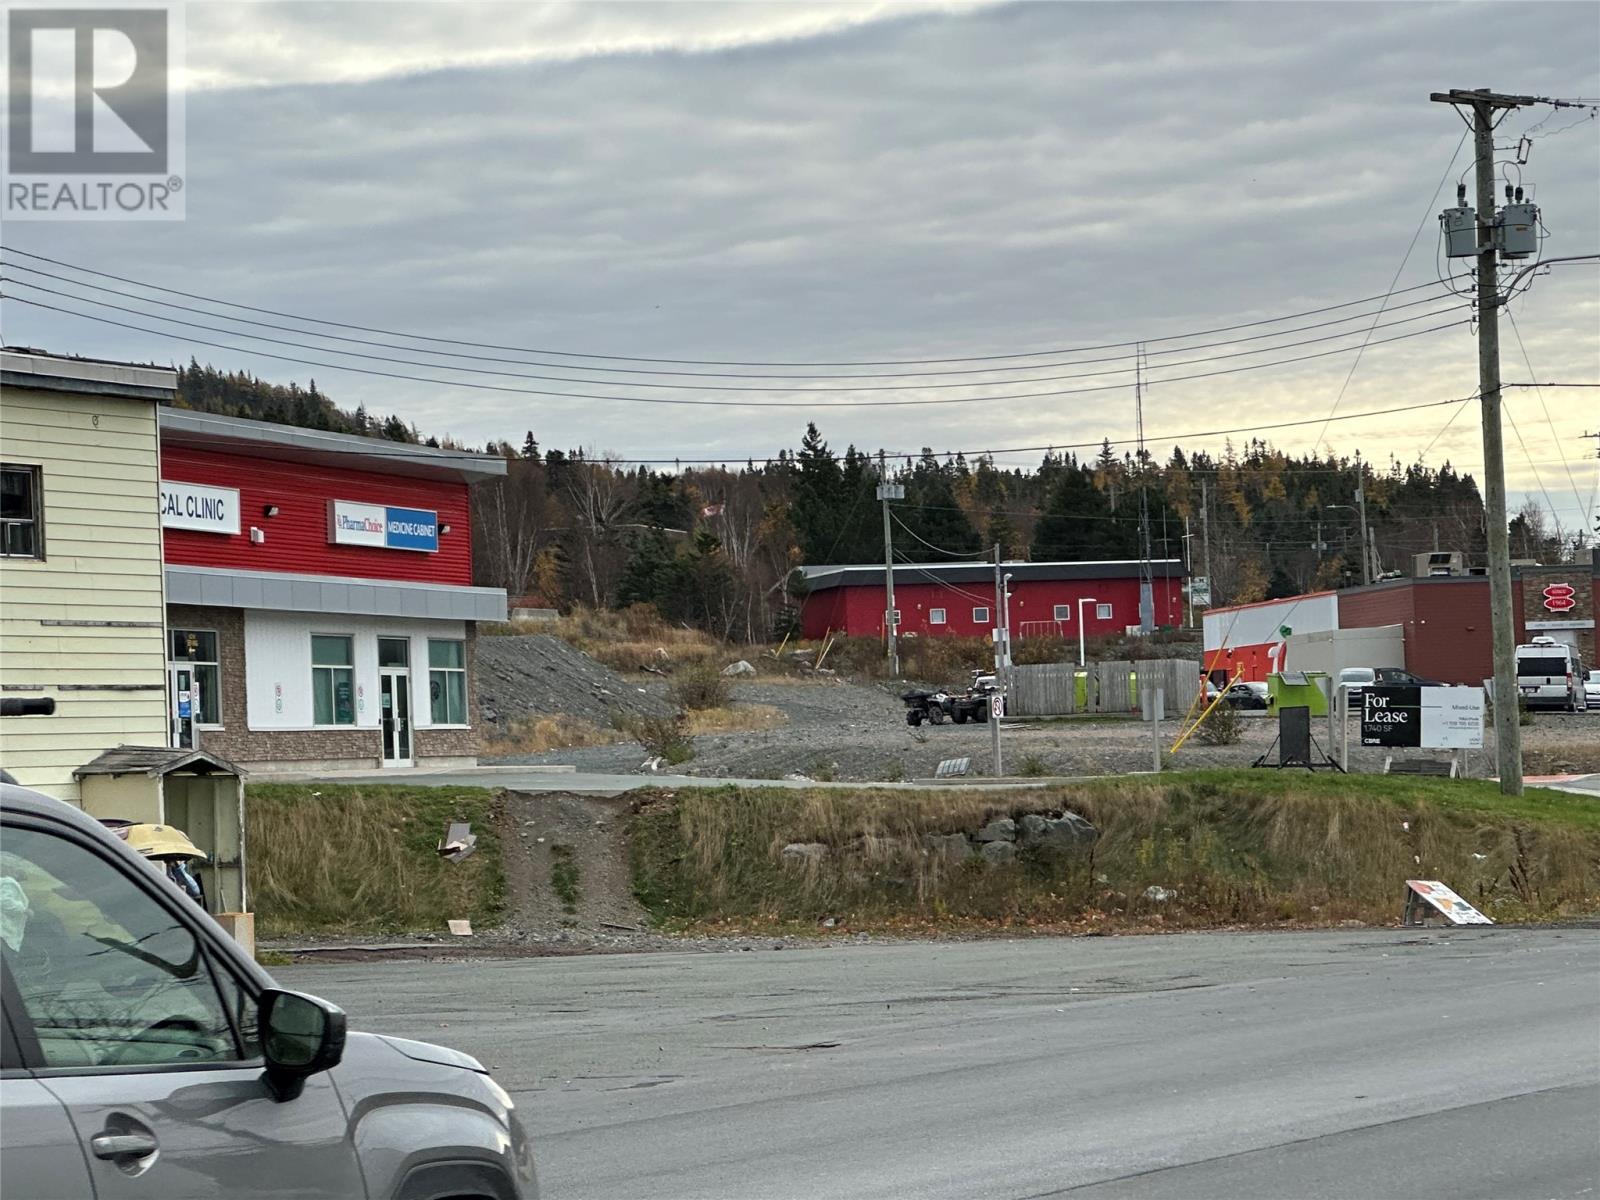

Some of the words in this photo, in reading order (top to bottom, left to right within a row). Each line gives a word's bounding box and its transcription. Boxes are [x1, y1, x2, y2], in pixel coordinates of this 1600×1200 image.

[186, 495, 224, 521] CLINIC
[342, 515, 383, 534] PharmaChoice
[387, 521, 413, 536] MEDICINE
[413, 523, 435, 537] CABINET
[1364, 693, 1390, 708] For
[1364, 708, 1408, 723] Lease
[1383, 724, 1393, 732] SF
